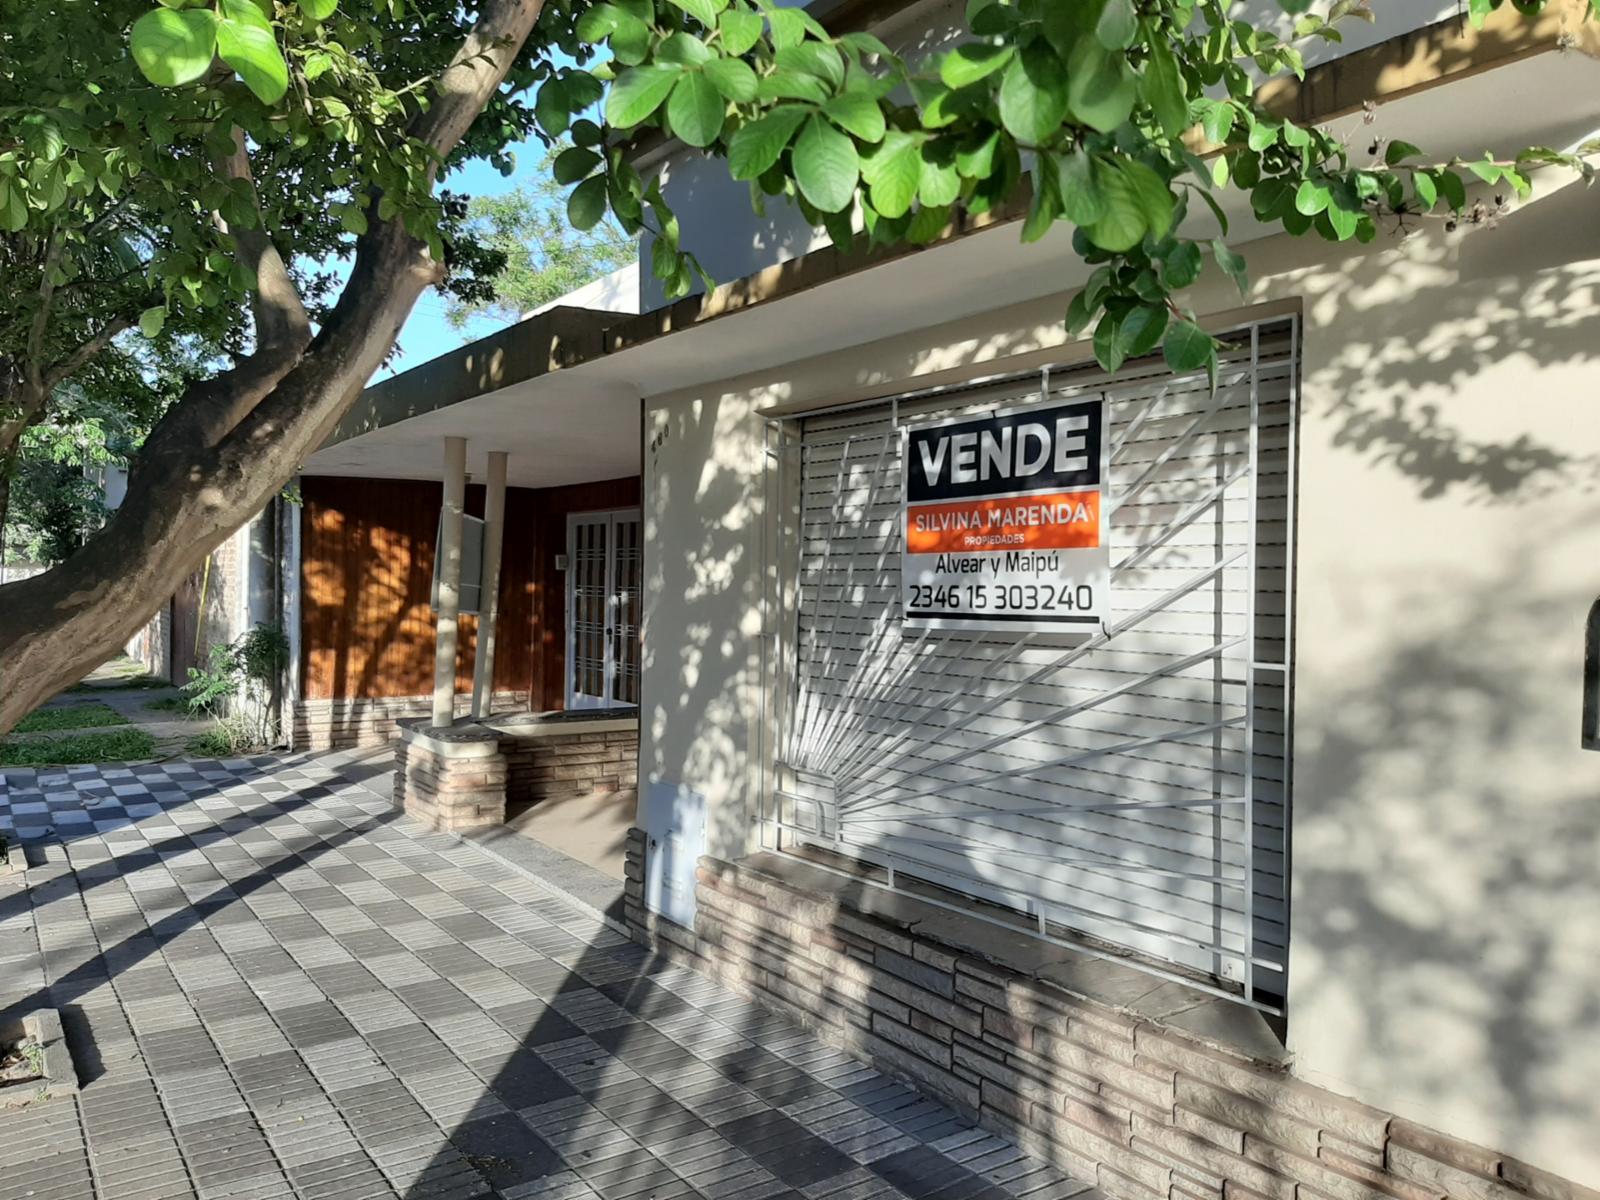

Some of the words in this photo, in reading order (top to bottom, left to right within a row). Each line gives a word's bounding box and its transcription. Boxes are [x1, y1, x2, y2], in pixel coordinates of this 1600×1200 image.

[918, 415, 1089, 487] VENDE
[916, 512, 982, 532] SILVINA
[988, 503, 1089, 528] MARENDA
[964, 534, 1024, 546] PROPIEDADES
[936, 553, 986, 573] Alvear
[991, 558, 1000, 579] y
[1005, 551, 1058, 579] Maipú
[909, 585, 960, 608] 2346
[966, 586, 987, 608] 15
[995, 585, 1092, 610] 303240
